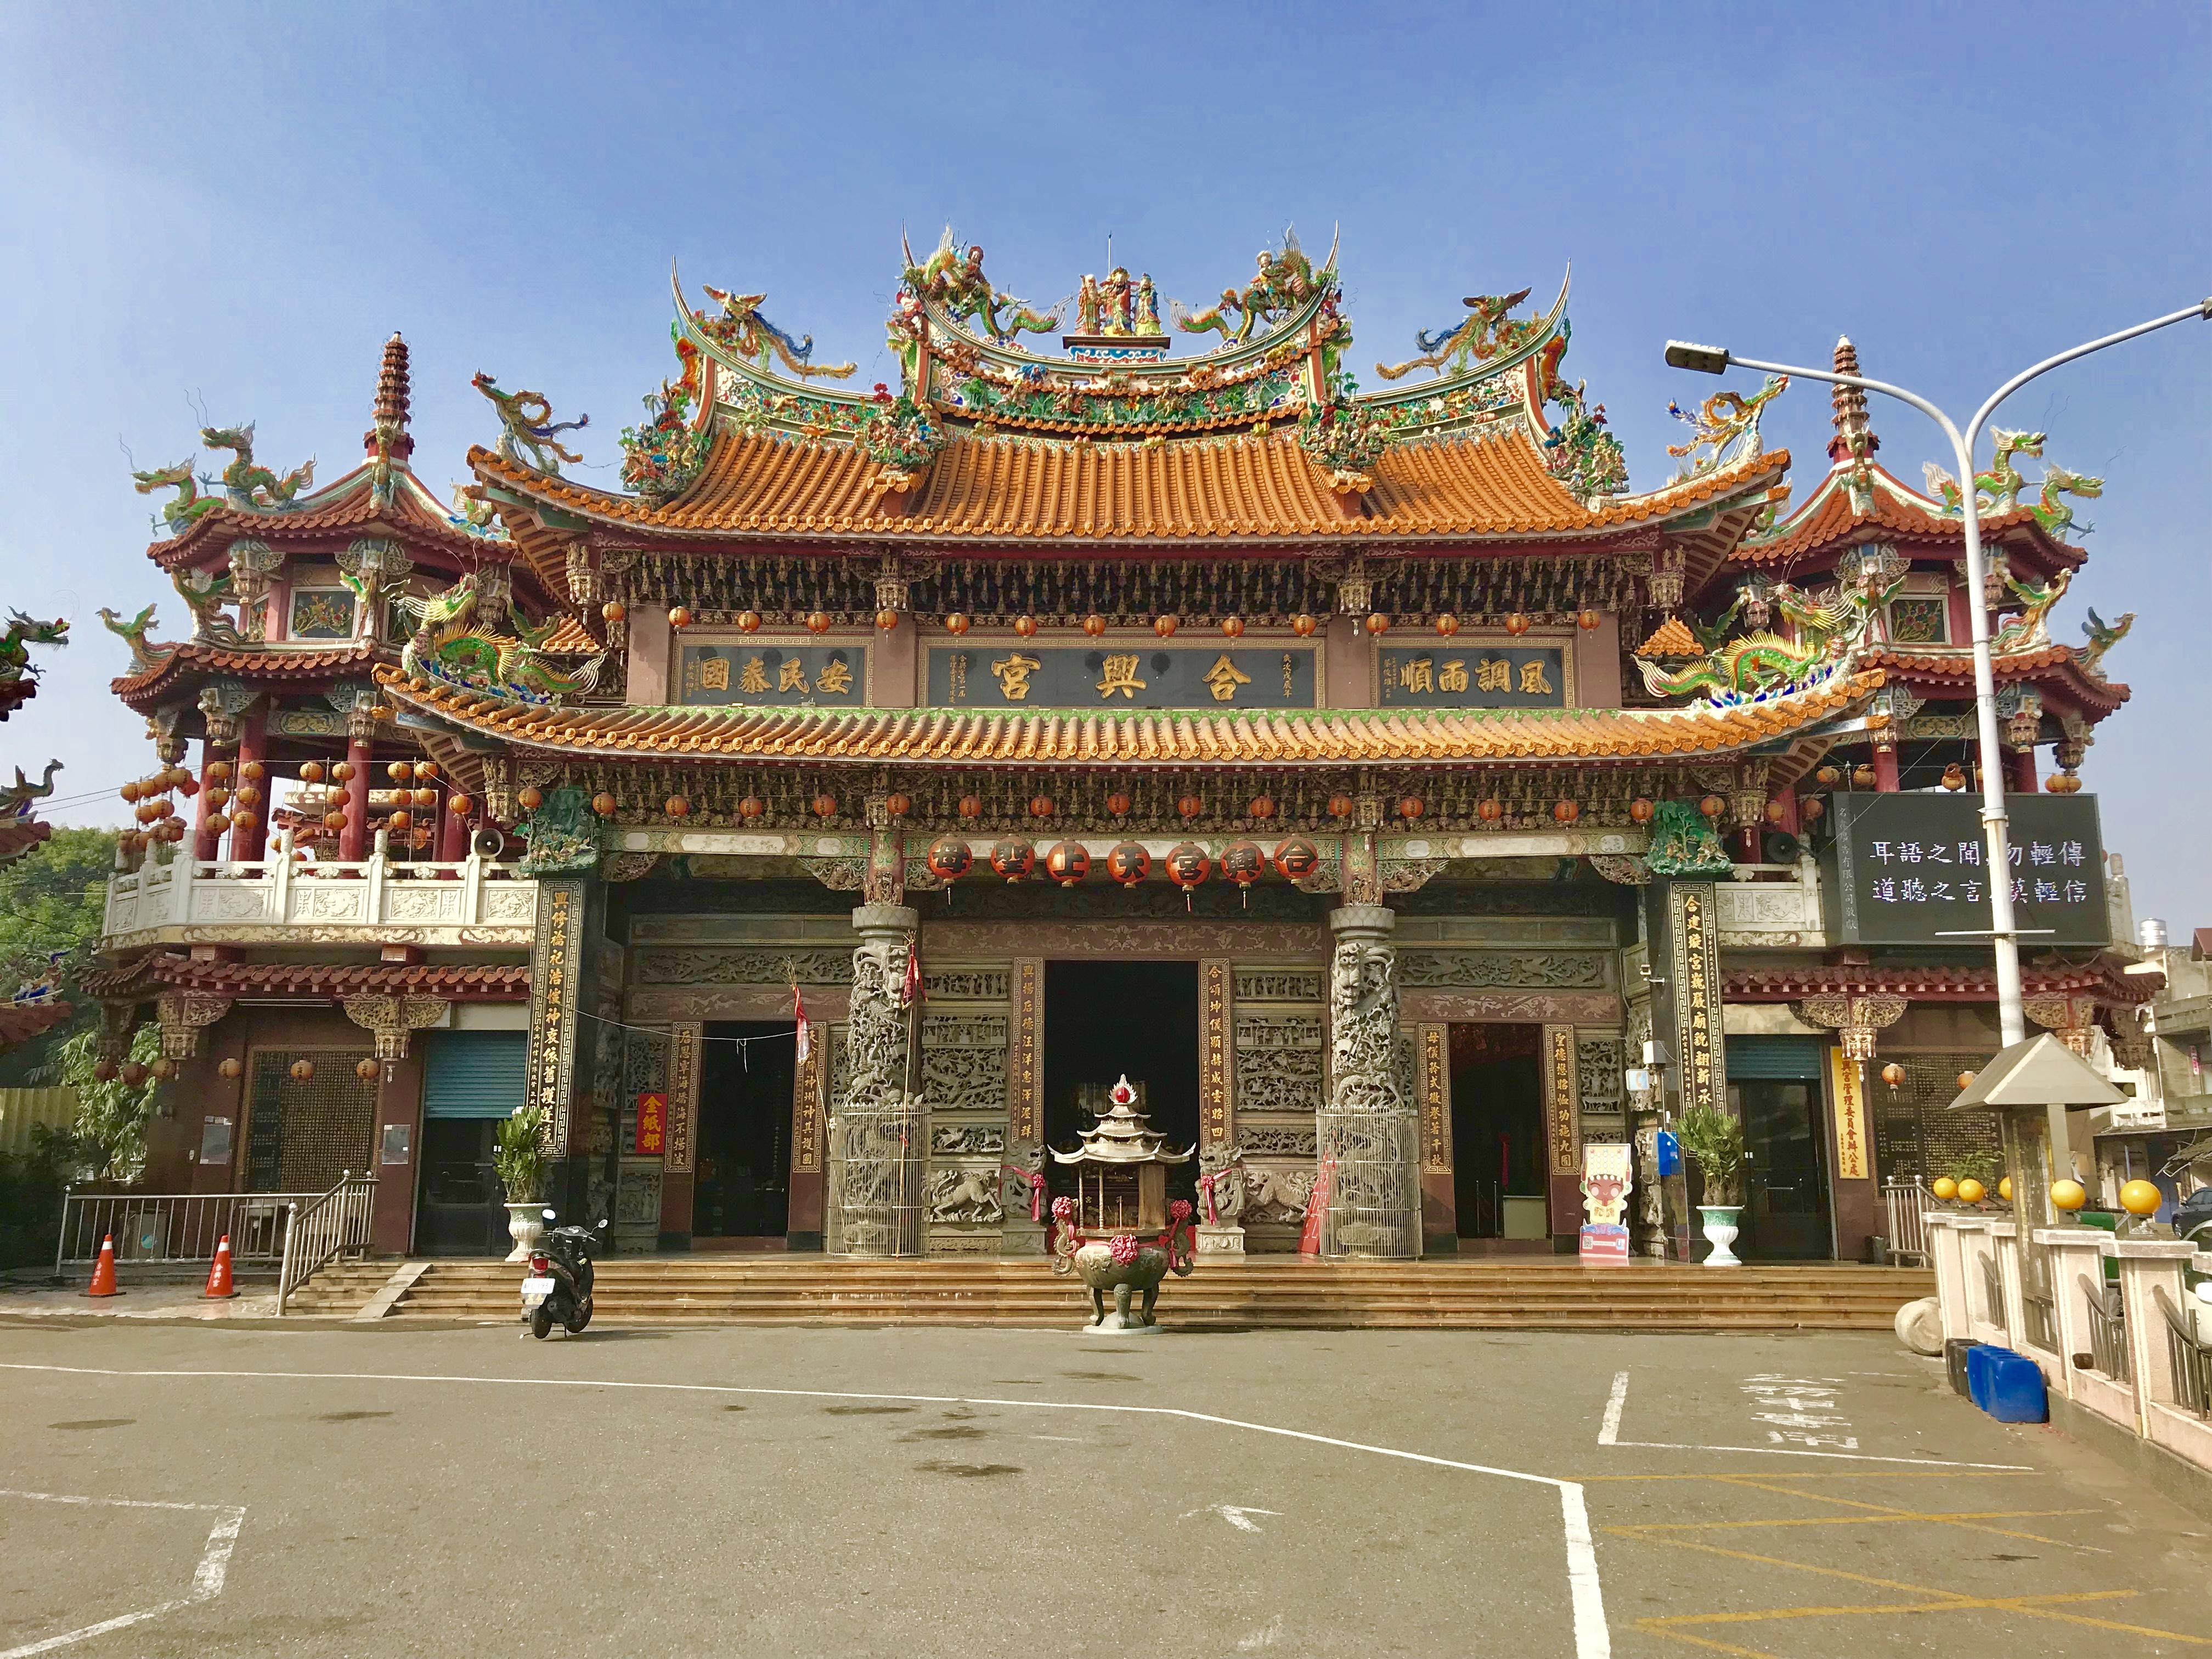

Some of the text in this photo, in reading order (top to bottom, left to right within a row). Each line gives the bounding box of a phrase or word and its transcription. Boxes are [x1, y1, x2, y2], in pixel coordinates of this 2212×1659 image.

[991, 652, 1252, 701] 合興宮
[1400, 658, 1553, 695] 風調雨順
[1020, 964, 1035, 1138] 興揚后德汪洋惠澤渥群
[1209, 966, 1223, 1137] 合頌坤儀顯赫威靈昭四
[641, 1095, 663, 1151] 金紙部
[1841, 1056, 1860, 1177] 興宮管理委員會辦公處
